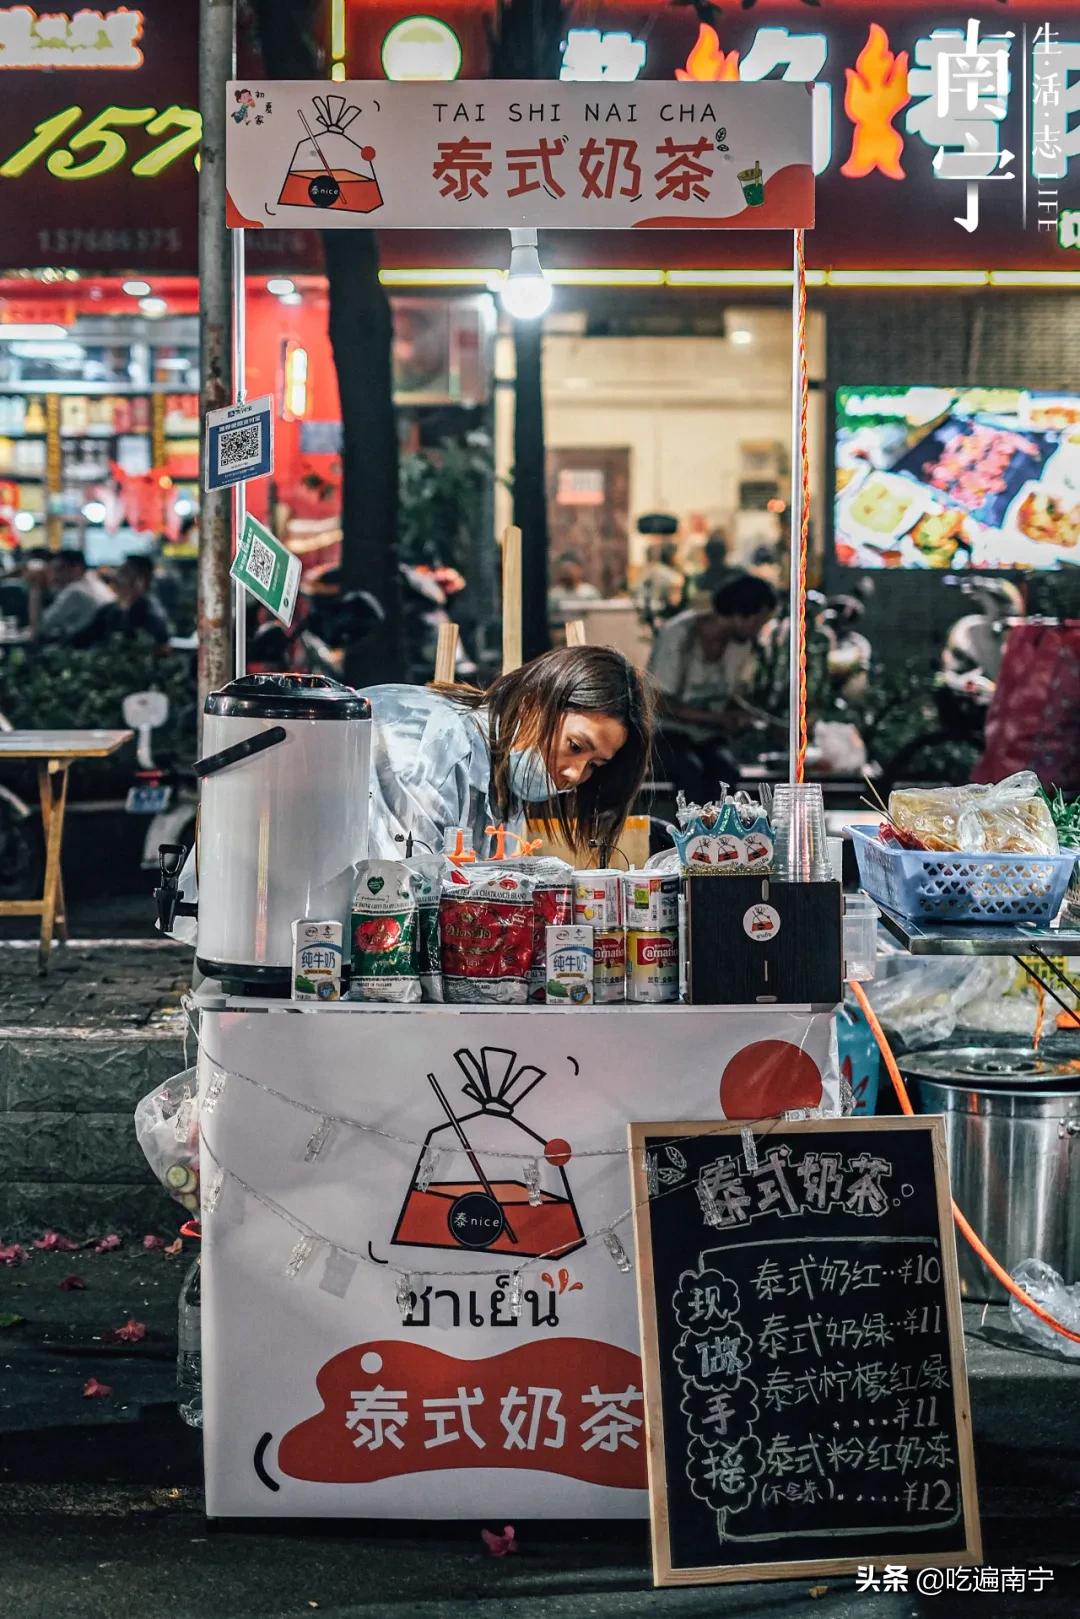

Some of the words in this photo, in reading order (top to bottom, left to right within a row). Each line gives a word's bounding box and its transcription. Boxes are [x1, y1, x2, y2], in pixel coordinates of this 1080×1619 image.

[432, 103, 486, 122] TAI
[508, 103, 561, 122] SHI
[584, 103, 637, 122] NAI
[659, 103, 717, 122] CHA
[0, 105, 201, 180] 157
[432, 136, 714, 201] 泰式奶茶
[301, 951, 336, 969] 纯牛奶
[553, 954, 587, 972] 纯牛奶
[697, 1146, 891, 1229] 泰式奶茶
[397, 1274, 559, 1327] ชาเย็น
[345, 1384, 643, 1453] 泰式奶茶
[766, 1431, 955, 1477] 泰式粉红奶冻
